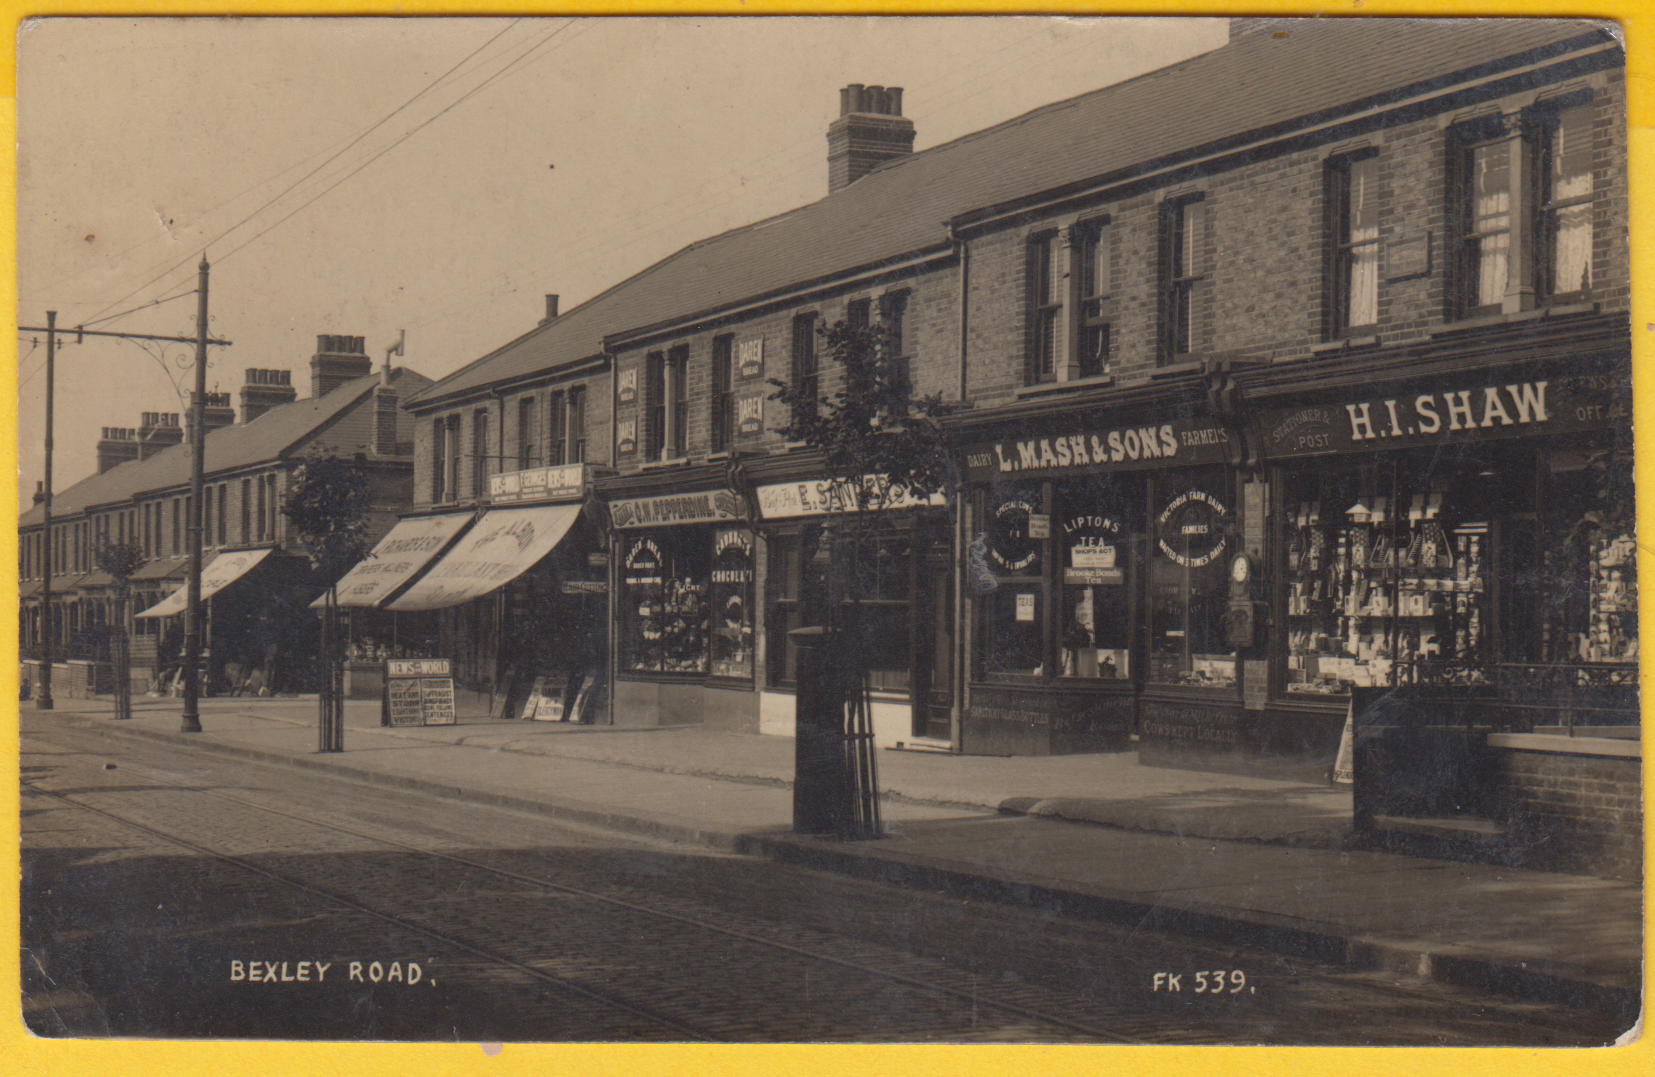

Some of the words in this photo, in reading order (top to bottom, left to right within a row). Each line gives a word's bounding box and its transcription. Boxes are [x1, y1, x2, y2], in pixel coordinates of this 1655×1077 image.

[742, 366, 759, 376] BREAD
[620, 392, 634, 401] BREAD
[741, 422, 759, 433] BREAD
[1273, 408, 1322, 443] STATIONER
[1322, 411, 1331, 425] &
[967, 452, 993, 467] DAIRY
[1108, 425, 1178, 461] SONS
[1298, 433, 1329, 448] POST
[620, 442, 633, 452] BREAD
[996, 500, 1016, 518] SPECIAL
[1160, 493, 1188, 523] VICTORIA
[1189, 491, 1206, 501] FARM
[1207, 495, 1227, 516] DAIRY
[1063, 515, 1120, 533] LIPTONS
[1181, 524, 1208, 534] FAMILIES
[1080, 536, 1105, 547] TEA
[1158, 537, 1177, 561] WAITED
[1176, 555, 1185, 565] ON
[1190, 554, 1209, 568] TIMES
[1209, 537, 1227, 560] DAILY
[1066, 568, 1095, 576] Brooke
[1096, 568, 1121, 576] Bonds
[1085, 576, 1102, 584] Tea
[389, 662, 415, 675] NEWS
[420, 661, 449, 674] WORLD
